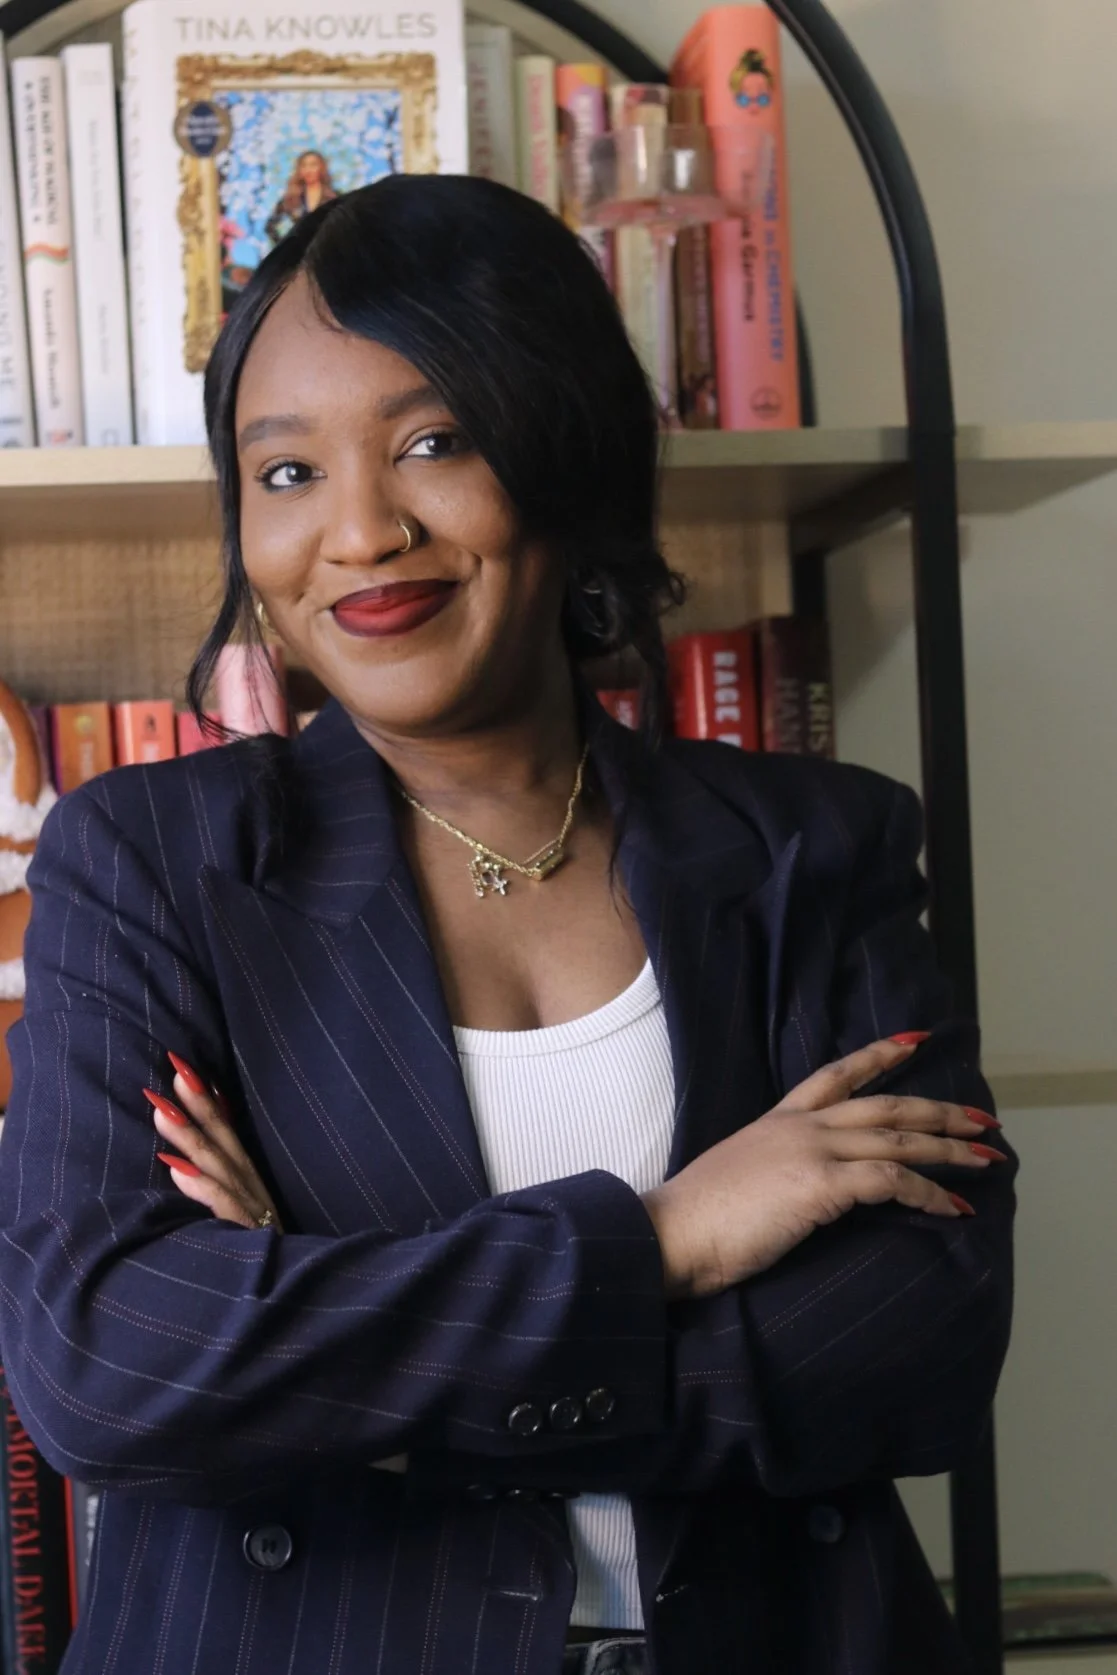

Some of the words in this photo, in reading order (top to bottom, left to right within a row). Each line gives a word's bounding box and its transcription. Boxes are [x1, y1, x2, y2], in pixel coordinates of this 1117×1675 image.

[175, 17, 250, 43] TINA
[265, 13, 437, 42] KNOWLES
[713, 650, 741, 723] RAGE
